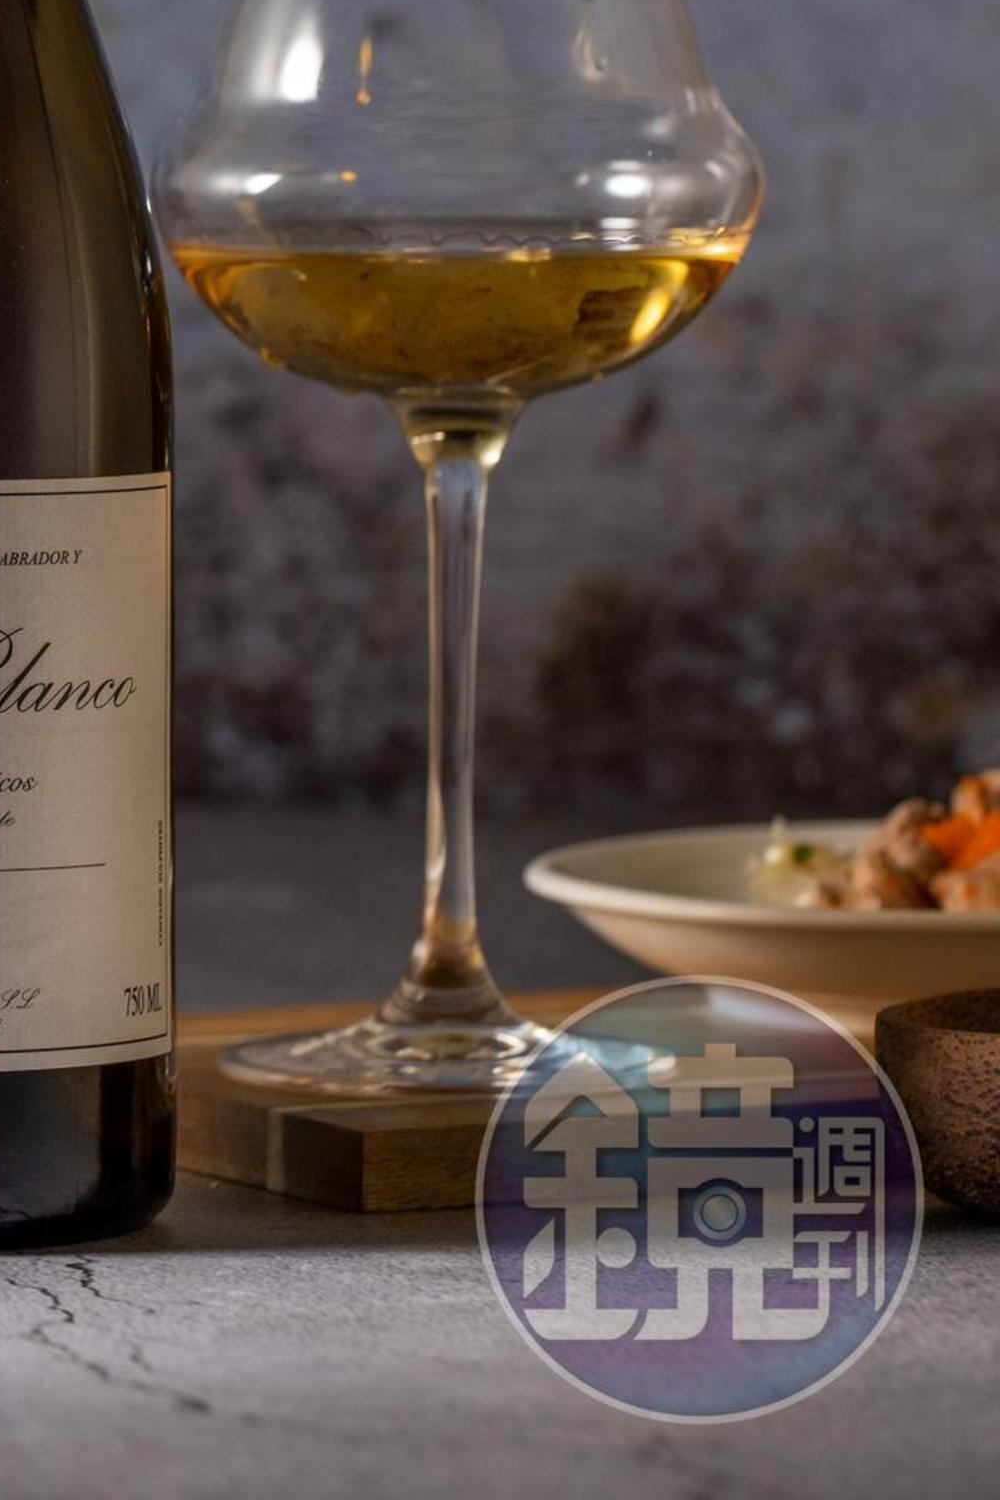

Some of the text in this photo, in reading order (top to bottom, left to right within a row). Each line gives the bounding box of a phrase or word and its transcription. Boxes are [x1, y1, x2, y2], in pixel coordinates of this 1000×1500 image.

[70, 549, 83, 565] Y
[123, 982, 163, 1018] 750 ML
